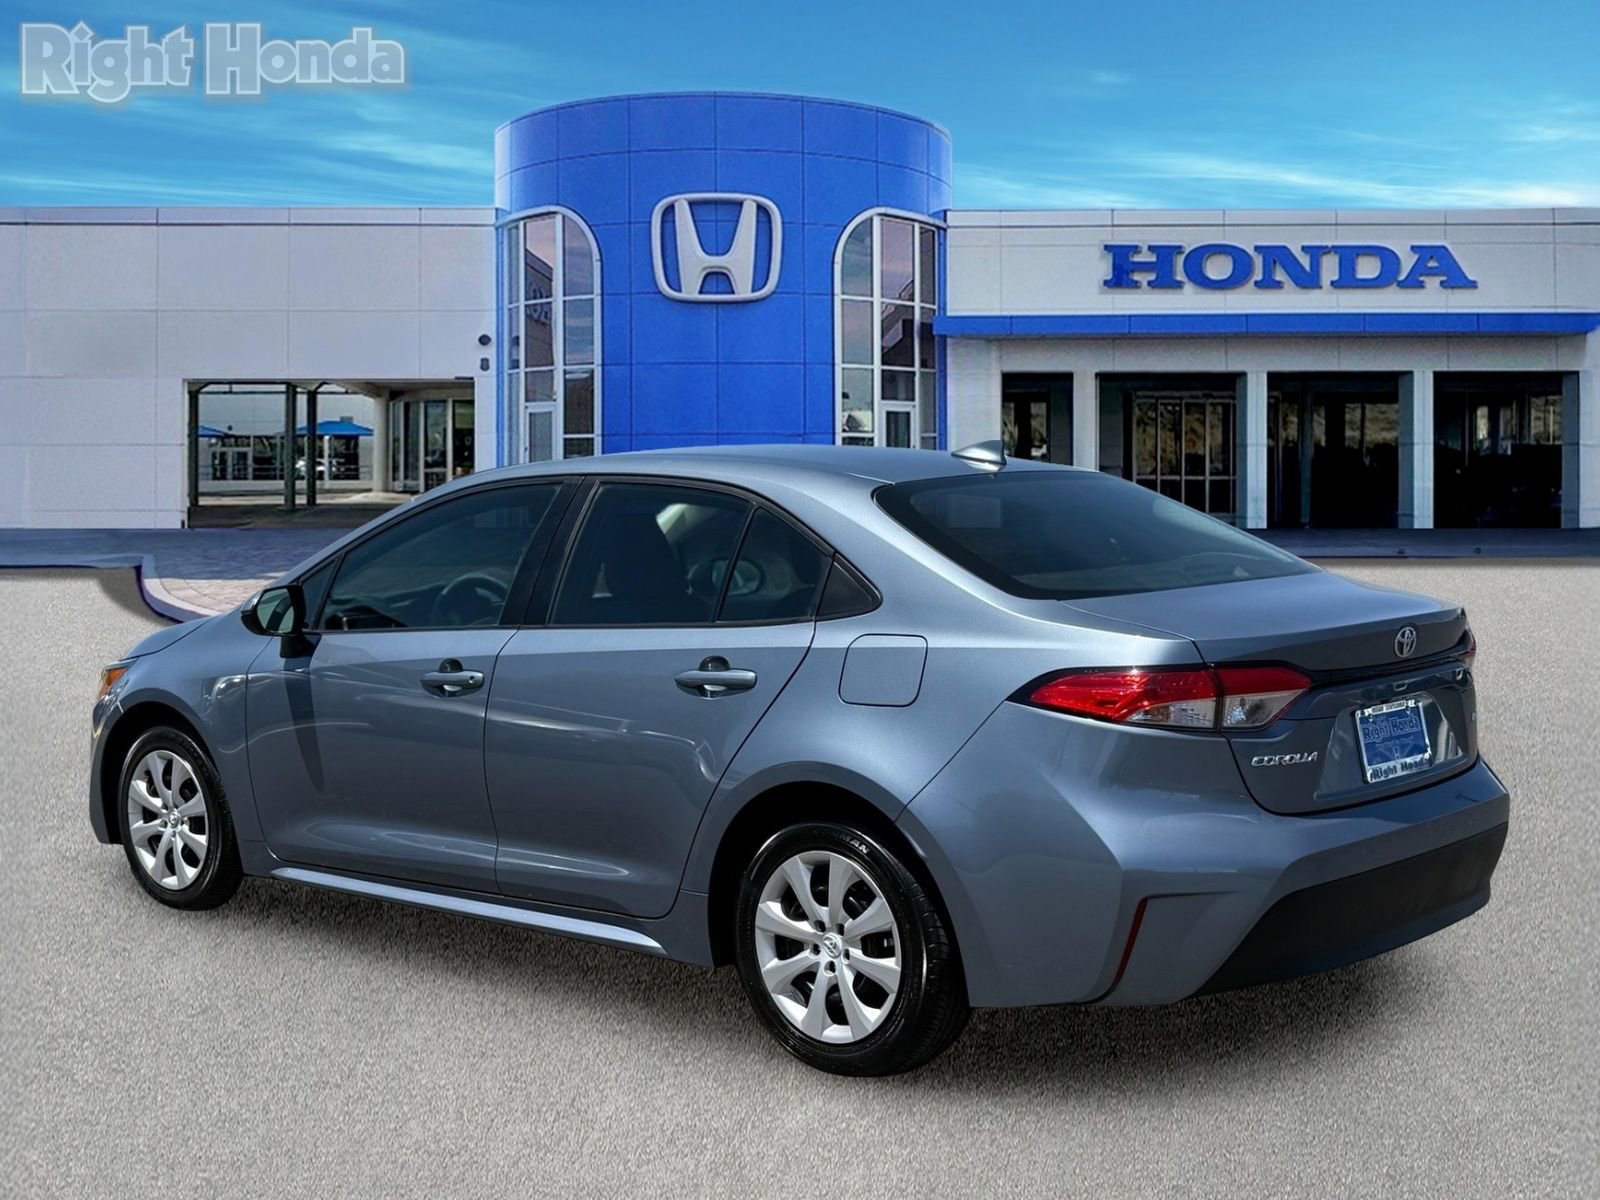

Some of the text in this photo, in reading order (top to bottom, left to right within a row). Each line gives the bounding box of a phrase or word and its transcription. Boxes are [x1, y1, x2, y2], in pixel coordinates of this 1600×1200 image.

[1103, 243, 1479, 290] HONDA
[1251, 751, 1319, 767] COROLLA
[1371, 764, 1398, 780] Right
